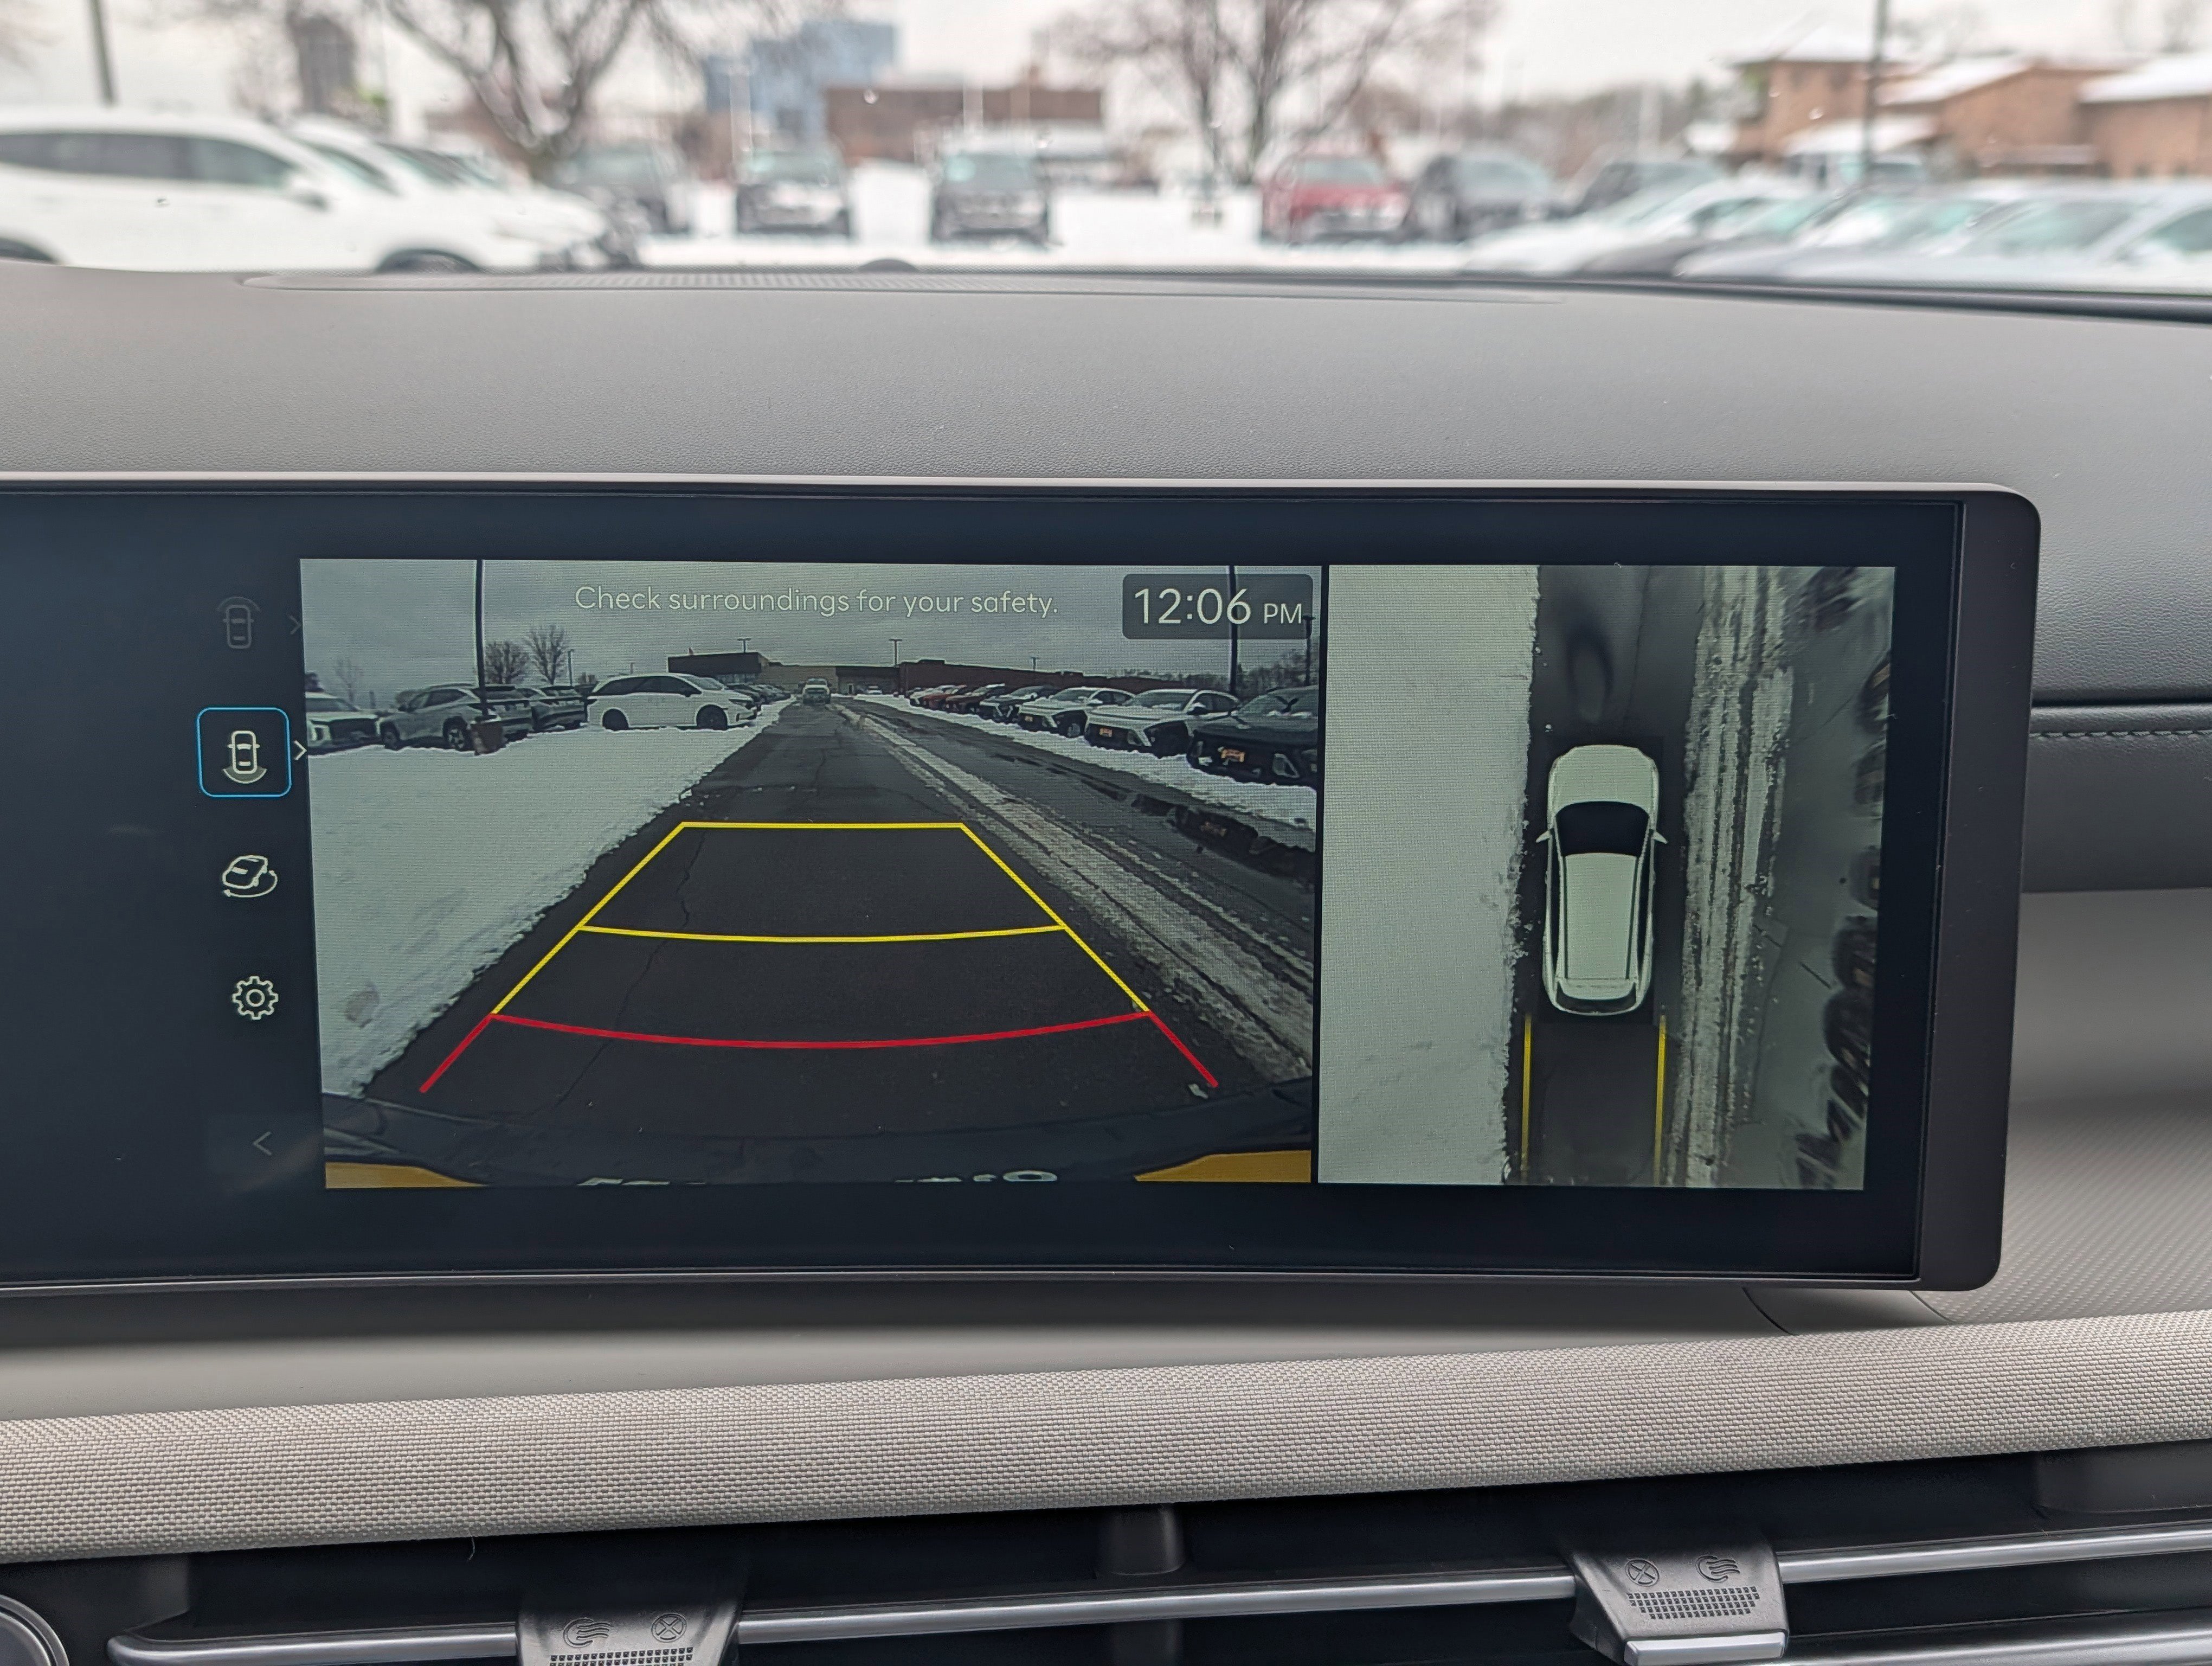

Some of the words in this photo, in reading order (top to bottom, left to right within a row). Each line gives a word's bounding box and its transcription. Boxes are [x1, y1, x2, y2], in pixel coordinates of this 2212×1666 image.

[576, 586, 662, 610] Check
[668, 588, 850, 617] surroundings
[856, 589, 896, 612] for
[903, 595, 964, 617] your
[970, 591, 1058, 618] safety.
[1134, 588, 1251, 624] 12:06
[1263, 603, 1302, 624] PM
